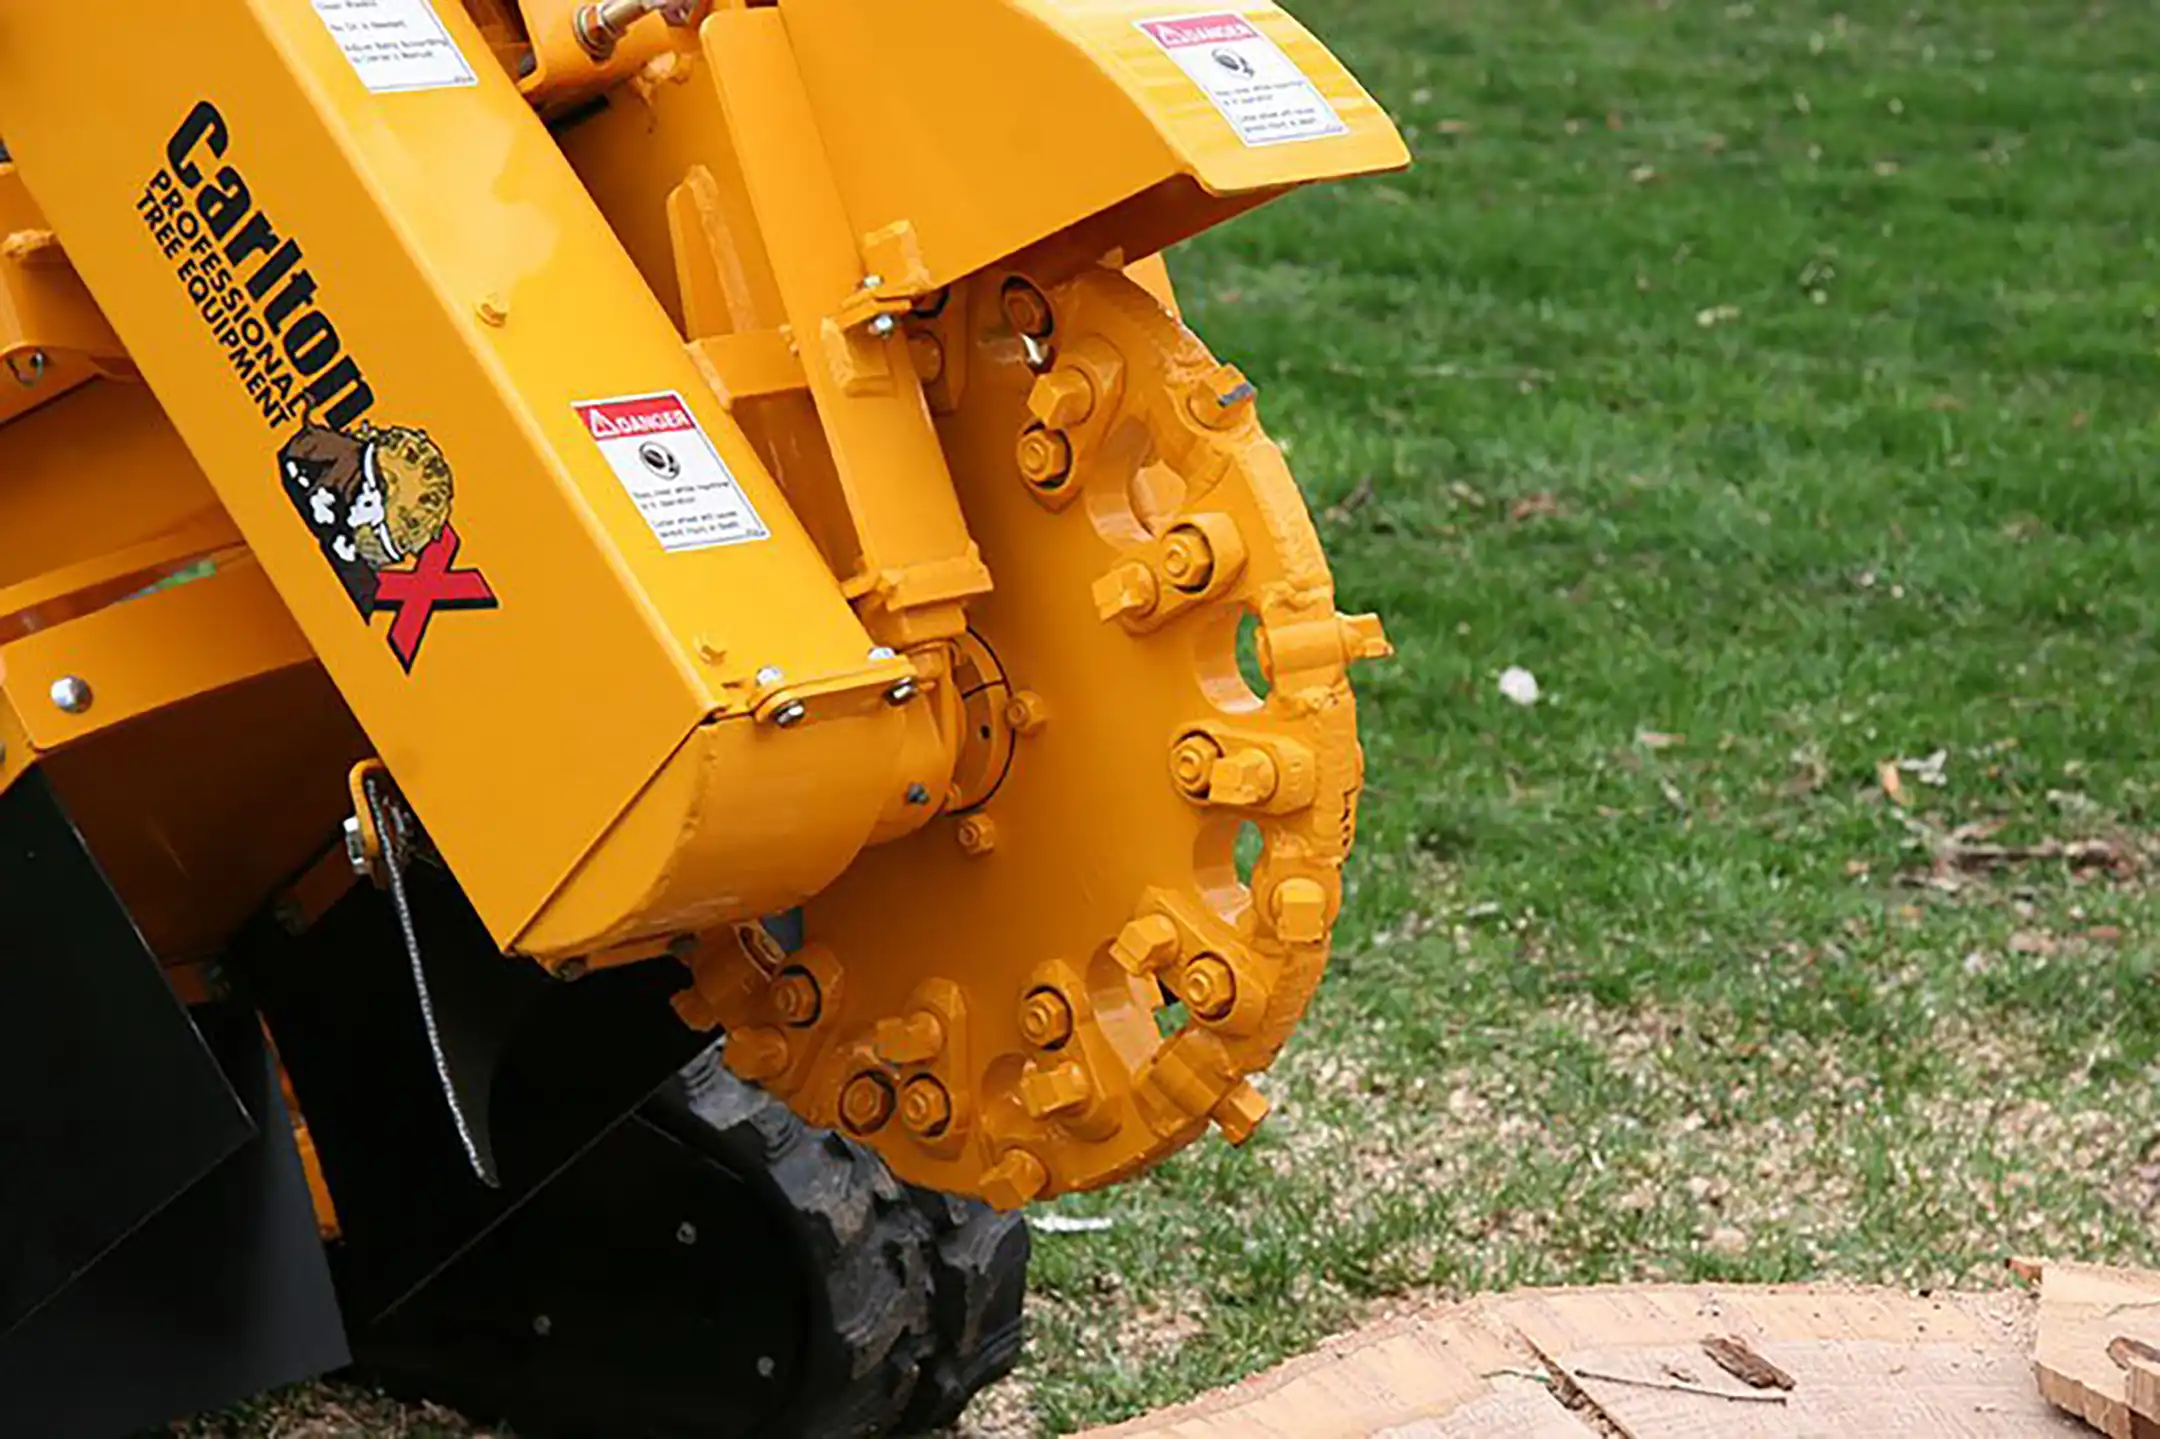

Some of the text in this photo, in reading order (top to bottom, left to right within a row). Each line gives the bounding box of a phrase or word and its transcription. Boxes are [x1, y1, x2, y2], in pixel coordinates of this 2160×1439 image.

[136, 188, 291, 430] TREE EQUIPMENT
[149, 168, 301, 420] PROFESSIONAL
[166, 100, 375, 434] Carlton
[614, 409, 690, 434] DANGER
